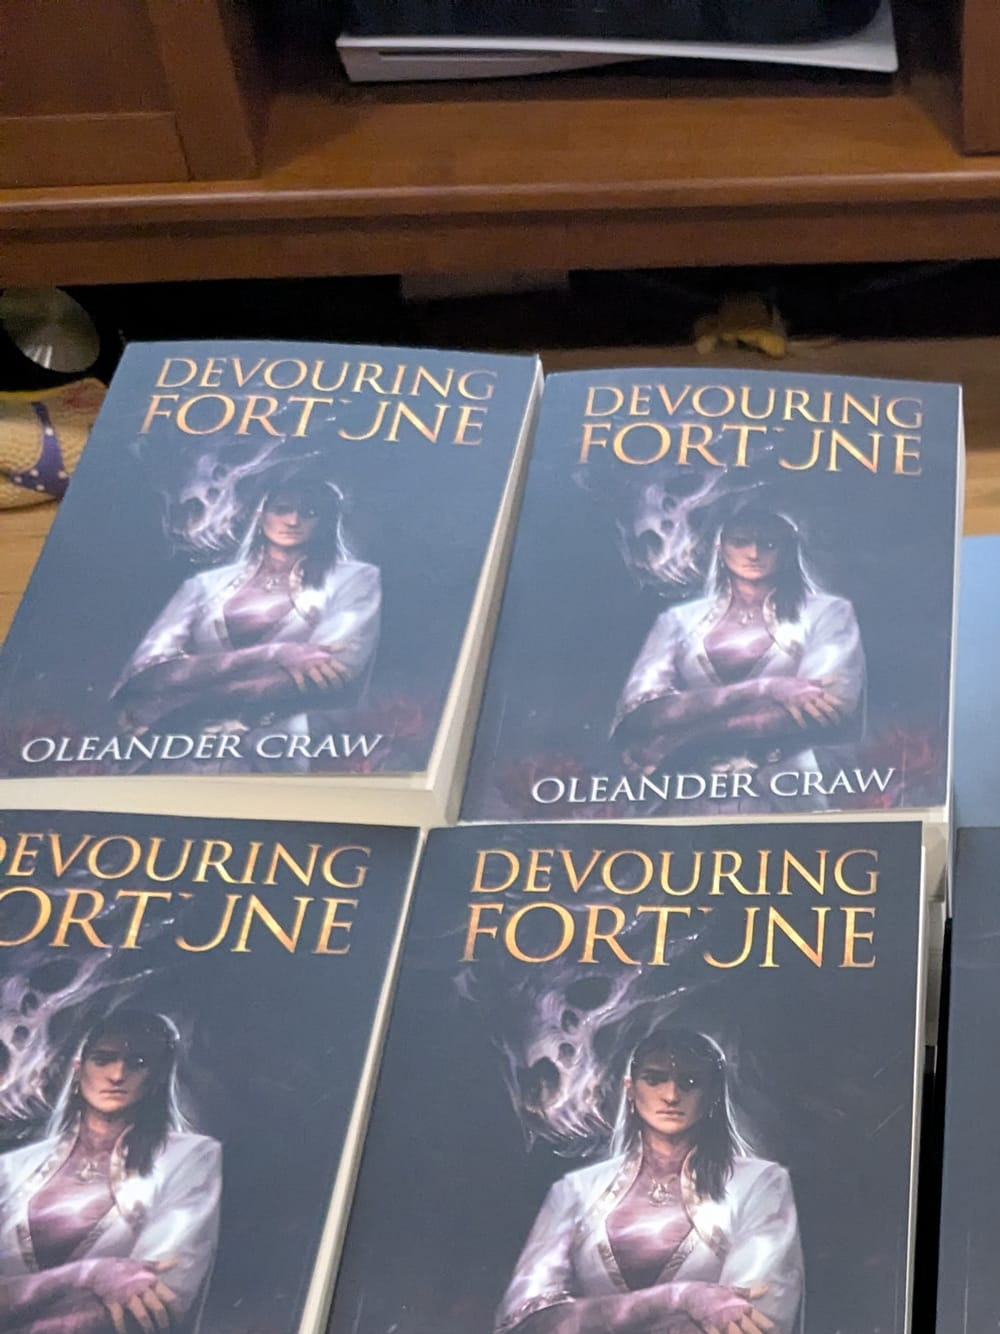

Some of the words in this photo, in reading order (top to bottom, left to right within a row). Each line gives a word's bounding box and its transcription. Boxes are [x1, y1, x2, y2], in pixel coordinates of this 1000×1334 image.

[154, 357, 498, 400] DEVOURING
[584, 384, 924, 429] DEVOURING
[21, 735, 243, 763] OLEANDER
[255, 734, 383, 759] CRAW
[531, 774, 760, 803] OLEANDER
[770, 768, 895, 796] CRAW
[471, 847, 880, 898] DEVOURING
[0, 885, 360, 955] ORTUNE
